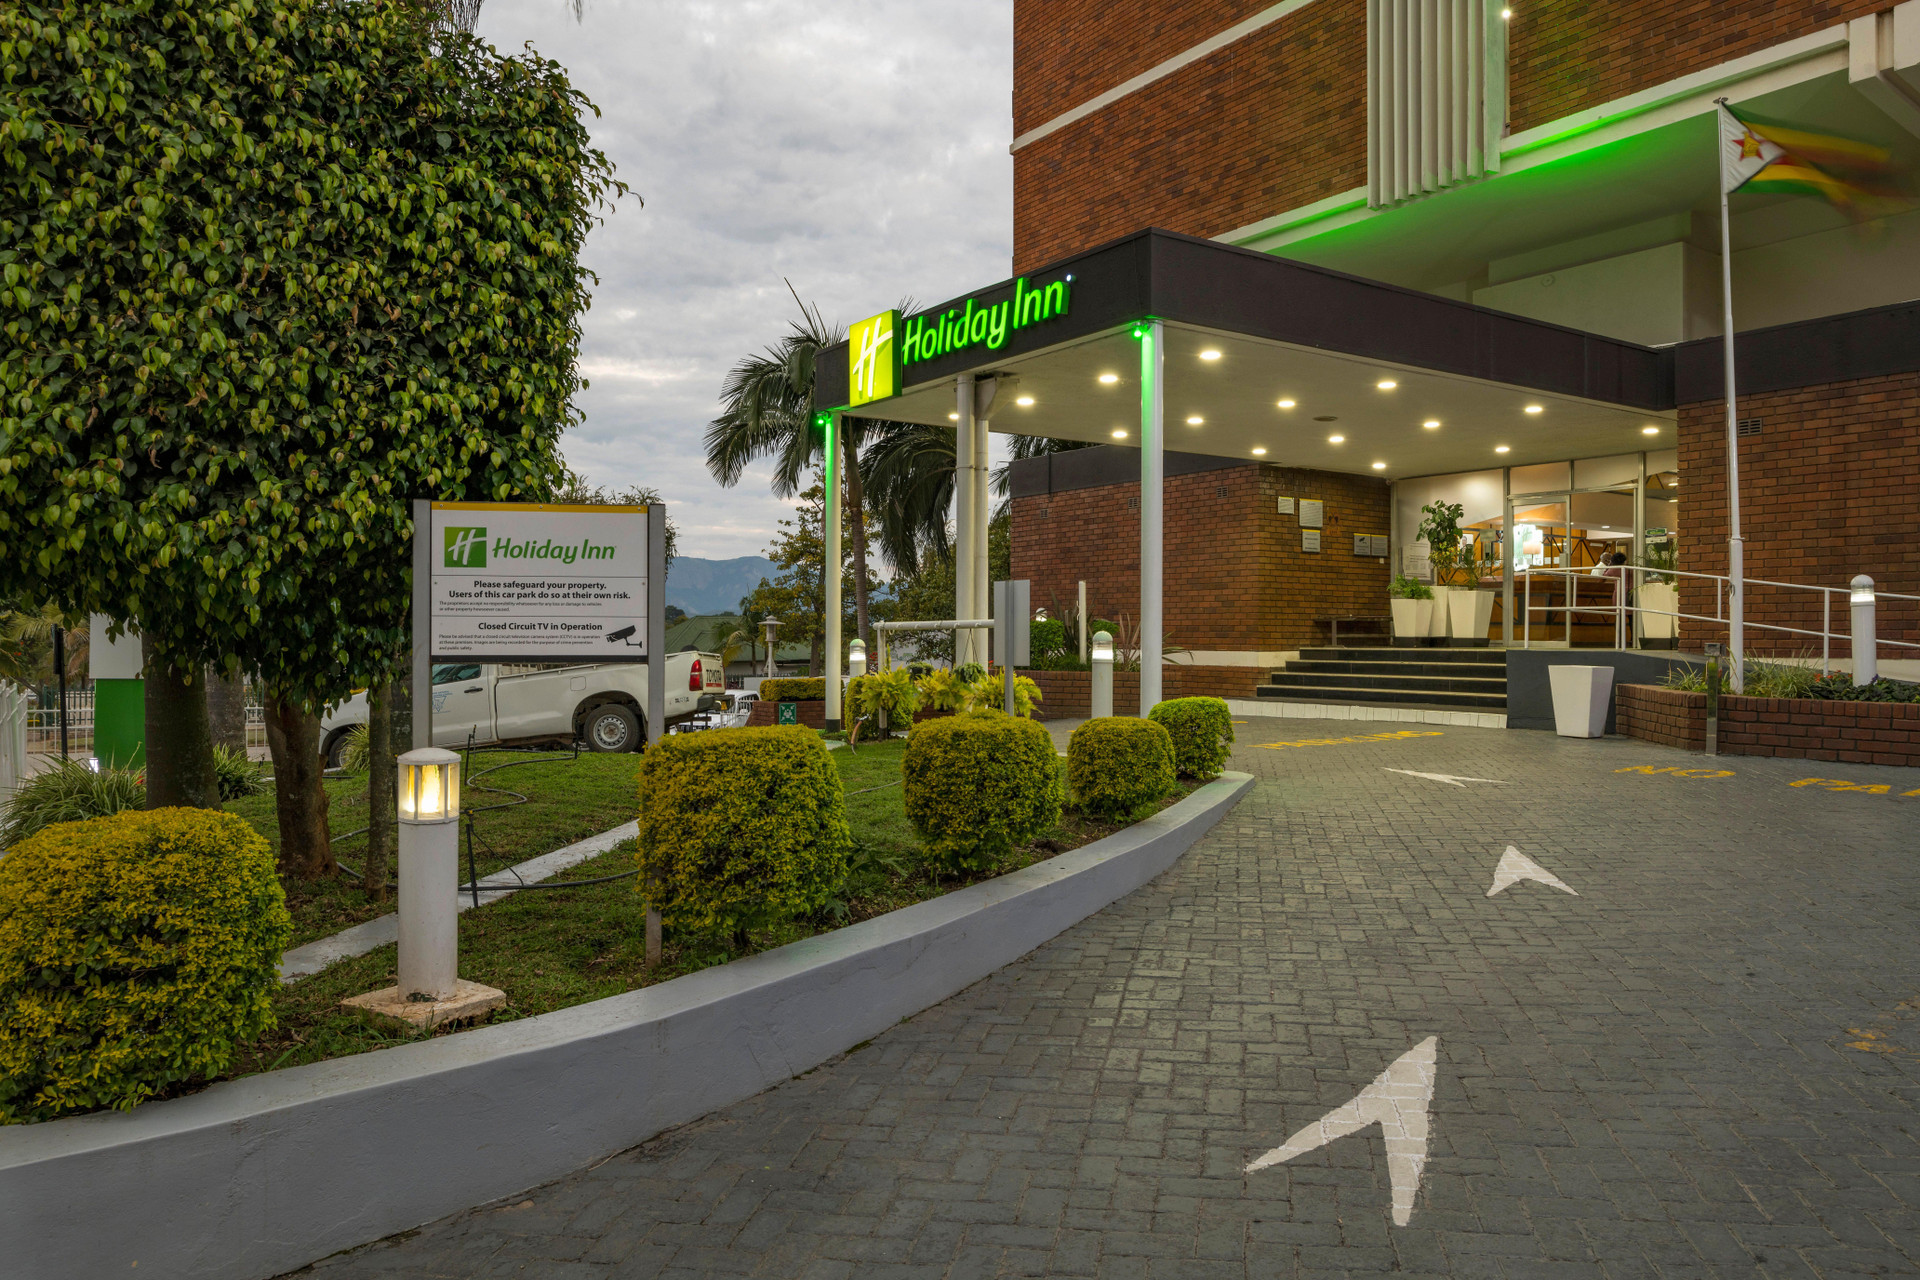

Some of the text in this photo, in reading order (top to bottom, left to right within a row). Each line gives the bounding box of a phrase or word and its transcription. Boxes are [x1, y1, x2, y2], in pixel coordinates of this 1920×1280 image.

[902, 277, 1068, 366] Holiday Inn
[492, 537, 578, 564] Holiday
[580, 538, 616, 560] Inn
[503, 580, 545, 590] safeguard
[567, 582, 607, 590] property.
[516, 591, 536, 600] park
[560, 623, 603, 632] Operation
[1612, 764, 1920, 797] NO PA
